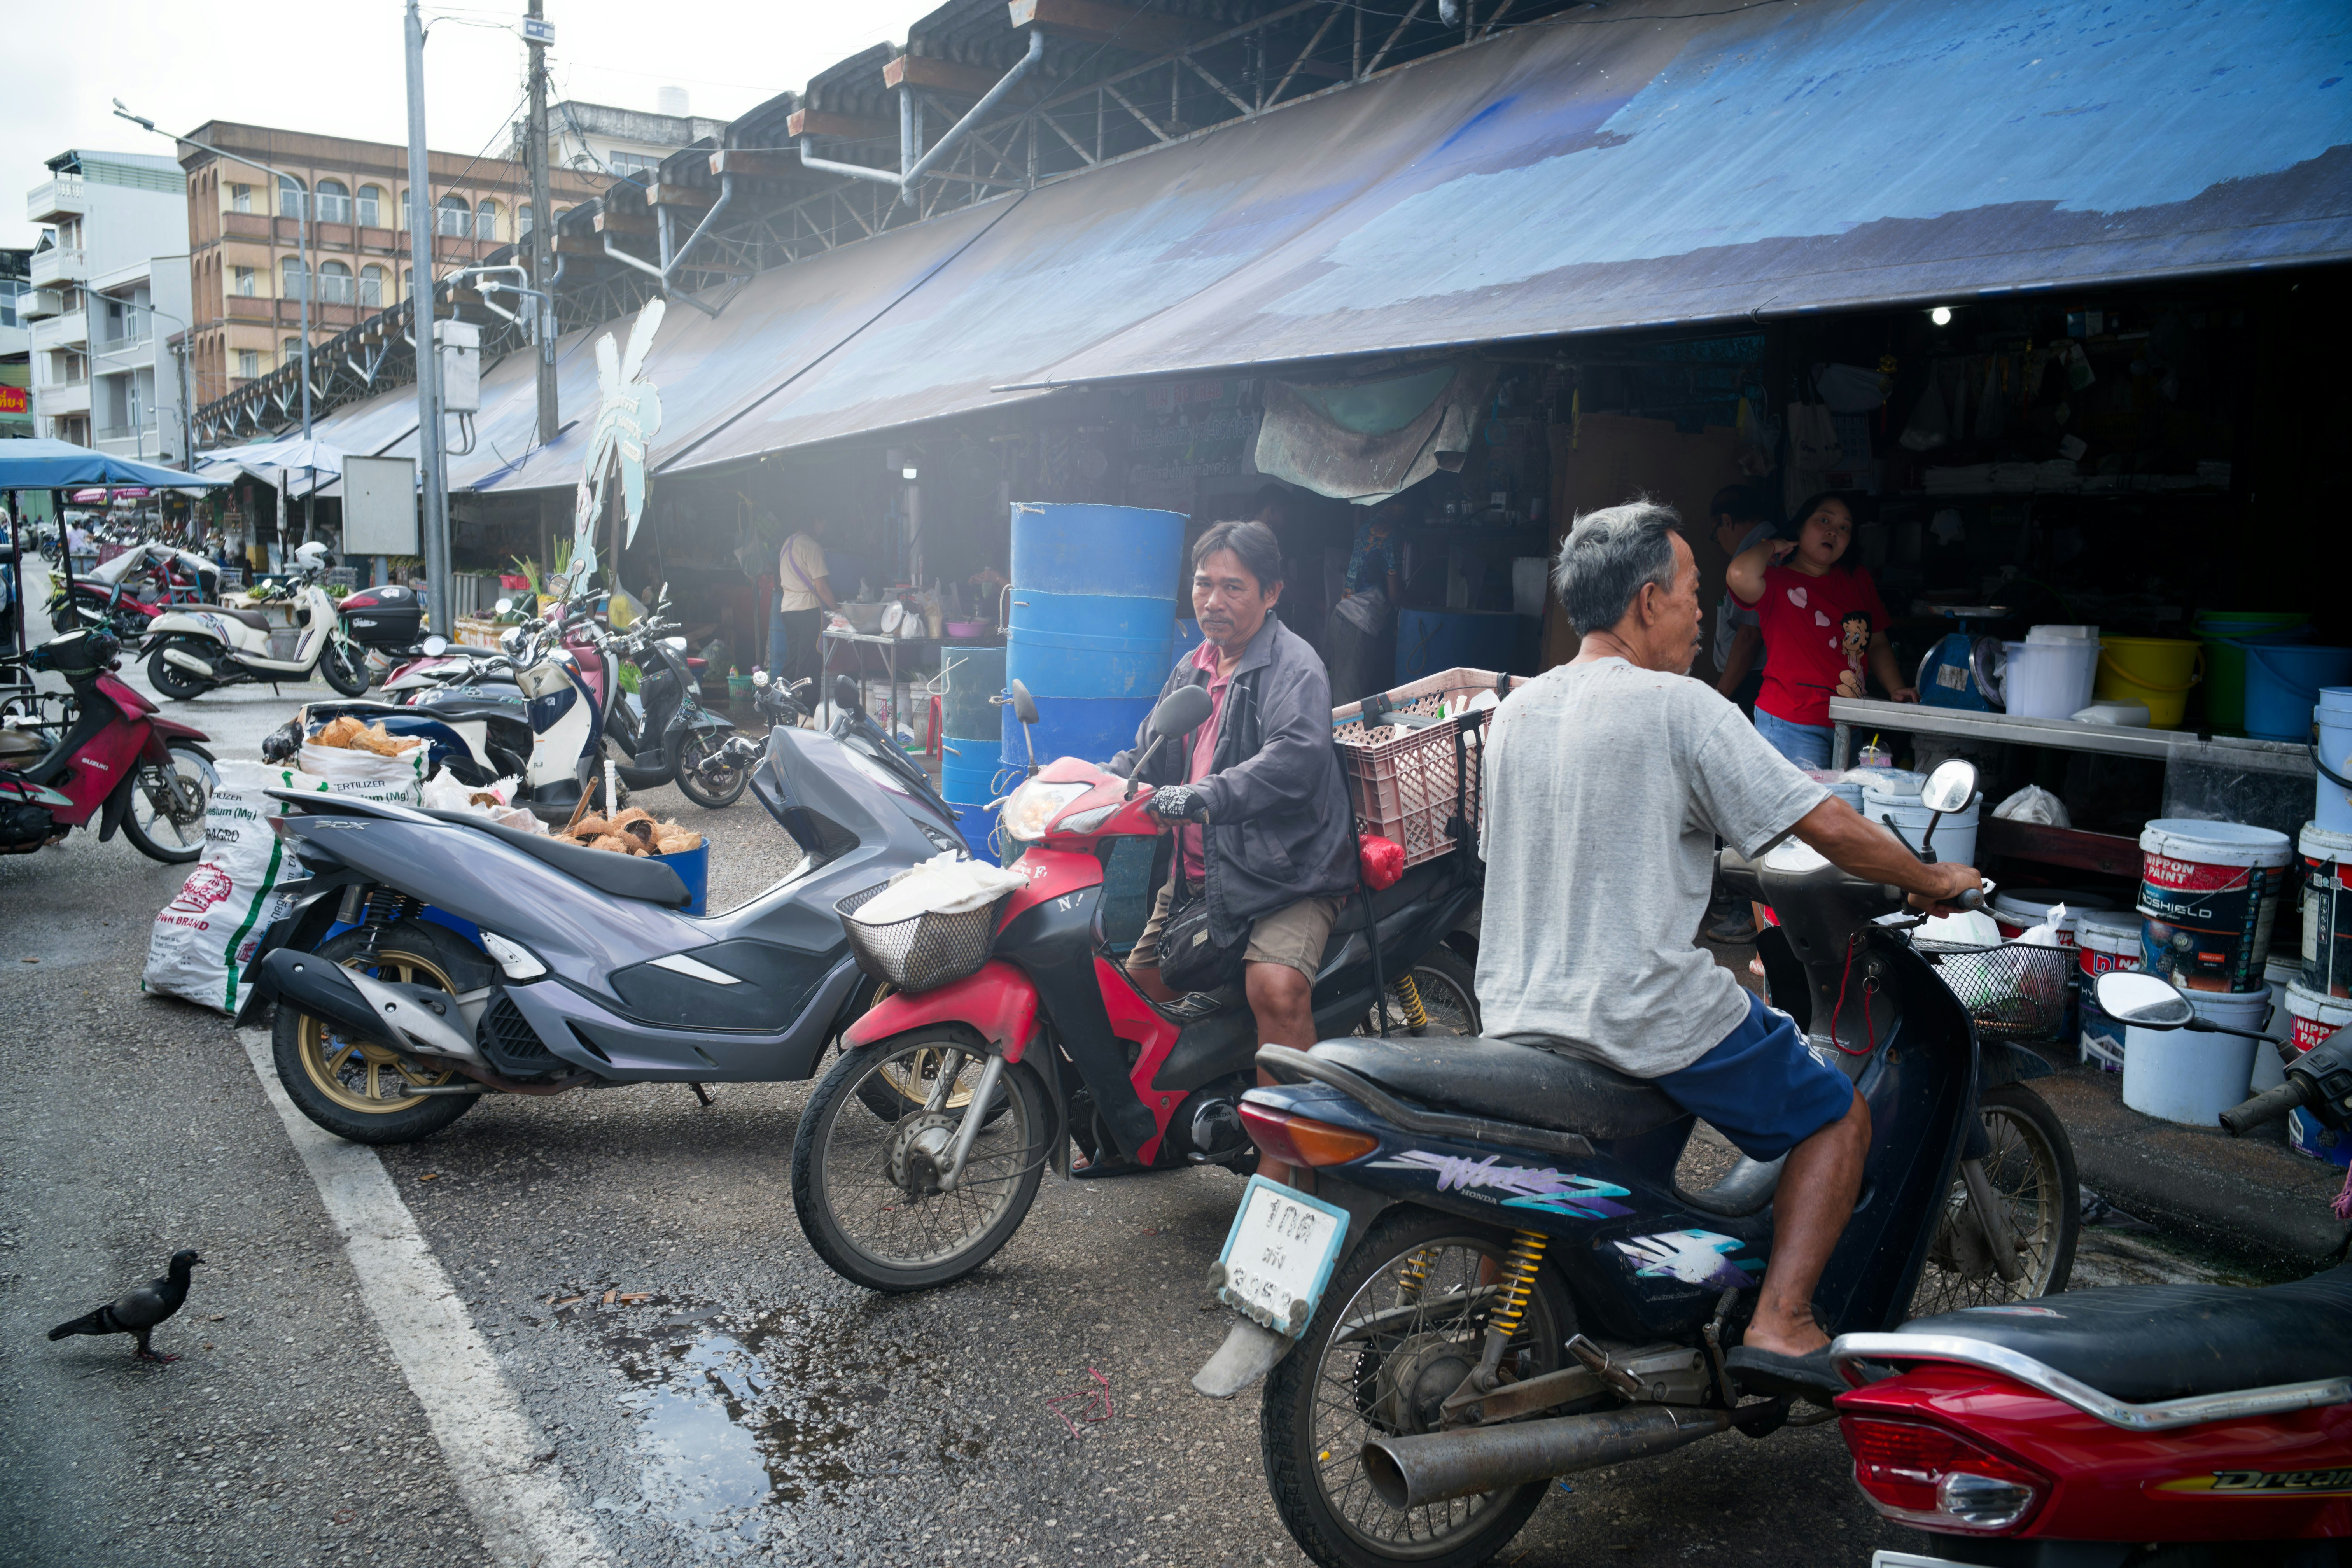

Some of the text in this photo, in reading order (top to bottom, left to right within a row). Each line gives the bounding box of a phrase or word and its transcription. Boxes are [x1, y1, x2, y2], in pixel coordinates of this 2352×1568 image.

[82, 757, 108, 771] SUZUKI
[385, 790, 409, 802] (Mg)
[234, 807, 257, 821] (Mg)
[313, 821, 370, 830] PCX
[2147, 854, 2195, 875] NIPPON
[2149, 866, 2187, 884] PAINT
[176, 916, 209, 931] BRAND
[2296, 1018, 2339, 1037] NIPP
[1437, 1155, 1577, 1193] Wave
[1460, 1188, 1497, 1205] HONDA
